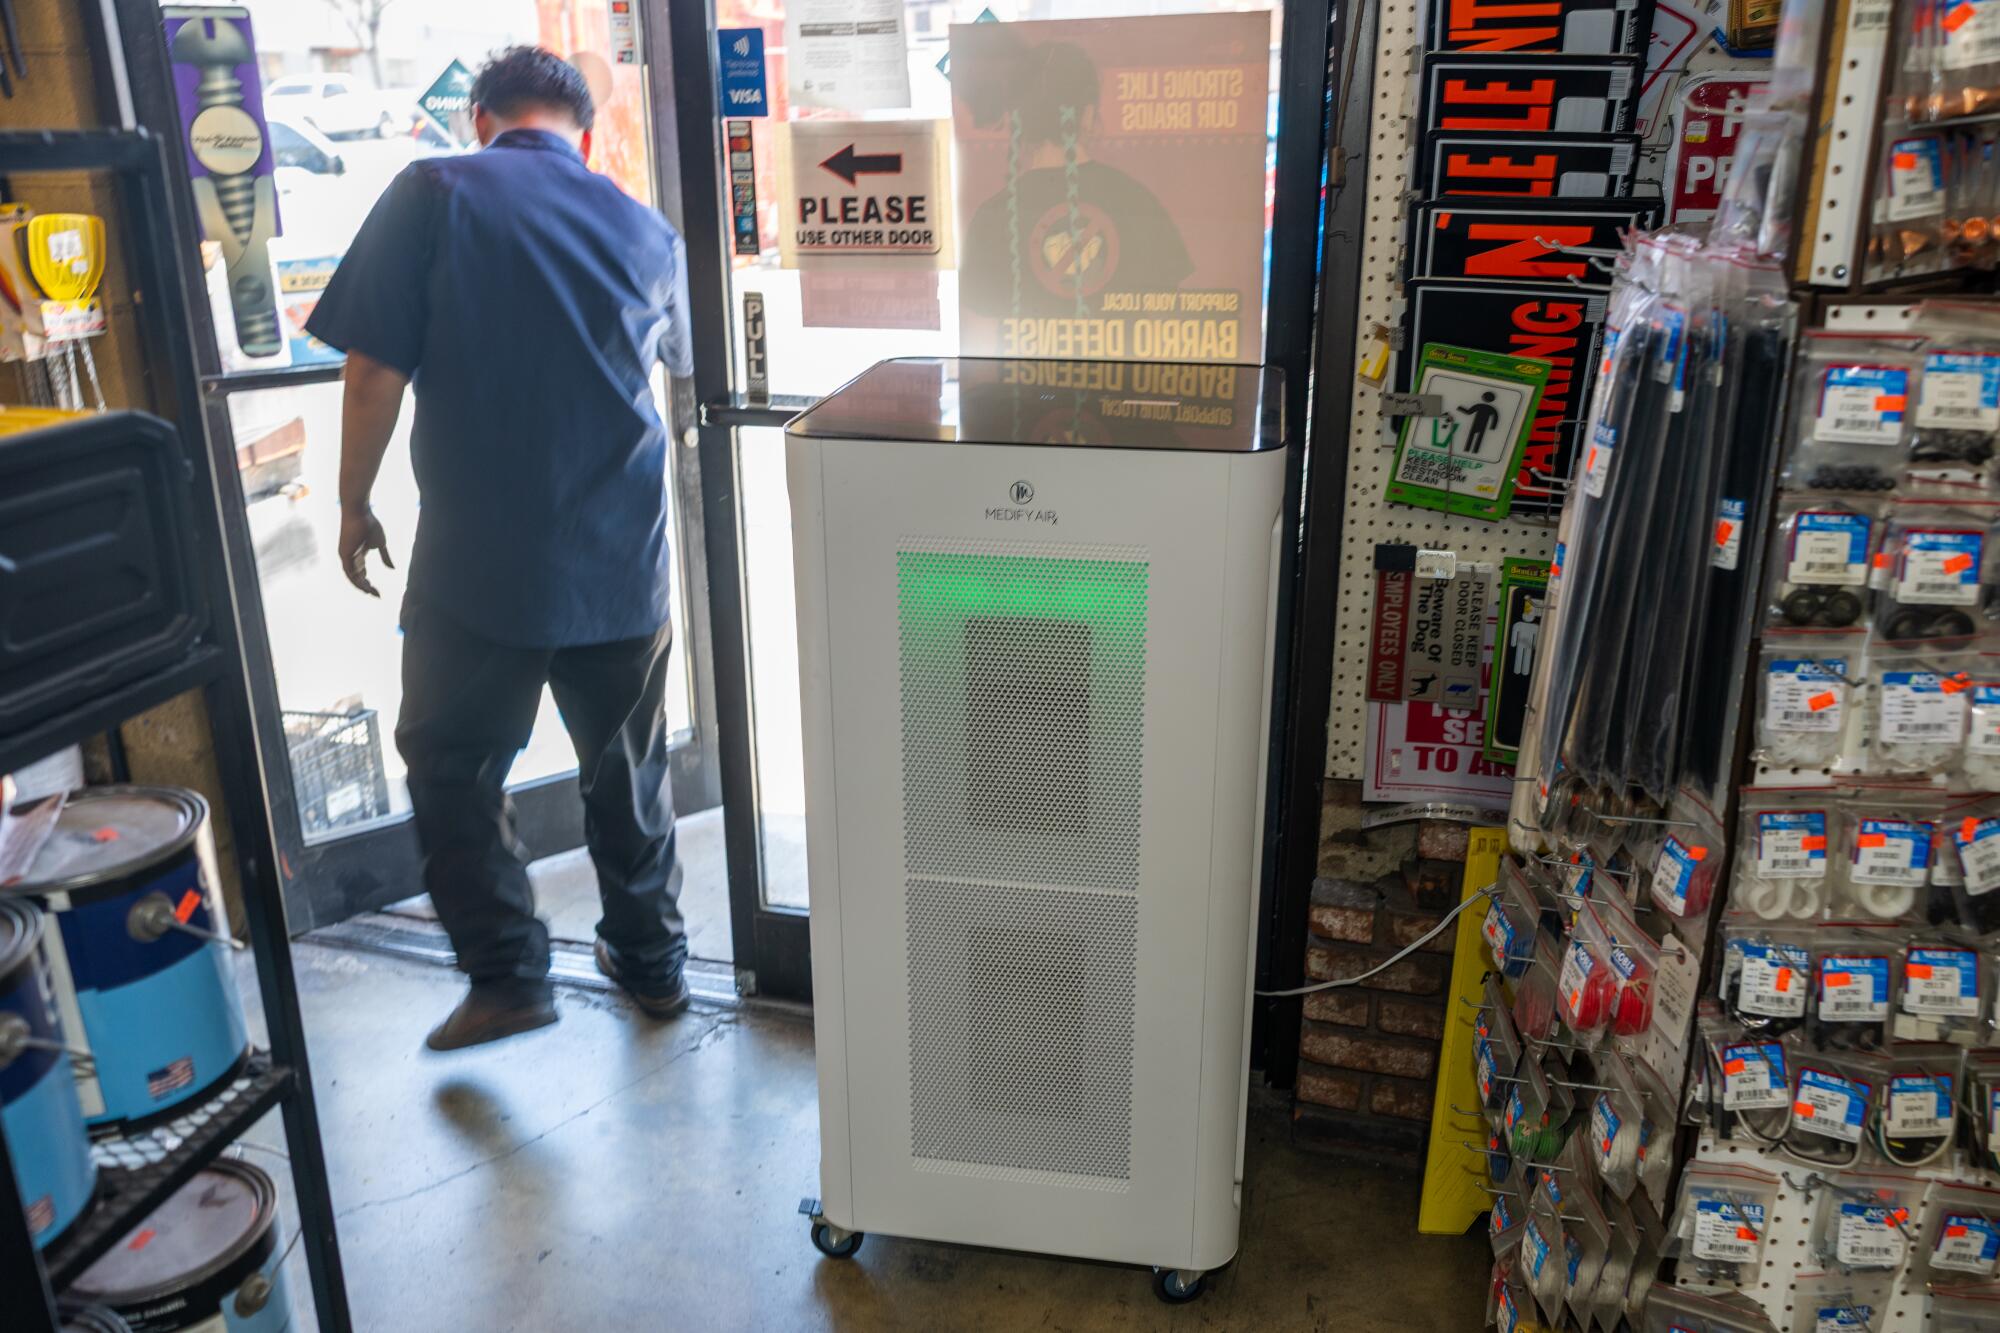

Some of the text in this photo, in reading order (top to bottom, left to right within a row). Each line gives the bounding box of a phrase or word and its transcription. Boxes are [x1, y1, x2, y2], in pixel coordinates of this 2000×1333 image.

[728, 88, 763, 104] VISA
[799, 196, 926, 224] PLEASE
[796, 230, 933, 244] USE OTHER DOOR
[747, 301, 765, 379] PULL
[1406, 455, 1463, 473] KEEP OUR
[1407, 448, 1483, 470] PLEASE HELP
[1401, 472, 1438, 485] CLEAN
[1403, 463, 1468, 483] RESTROOM
[1411, 584, 1433, 653] The Dog
[1430, 577, 1449, 664] Beware Of
[1450, 580, 1470, 666] DOOR CLOSED
[1467, 581, 1485, 668] PLEASE KEEP
[1376, 570, 1405, 696] EMPLOYEES ONLY
[1413, 746, 1459, 773] TO
[1614, 948, 1636, 973] NOBLE
